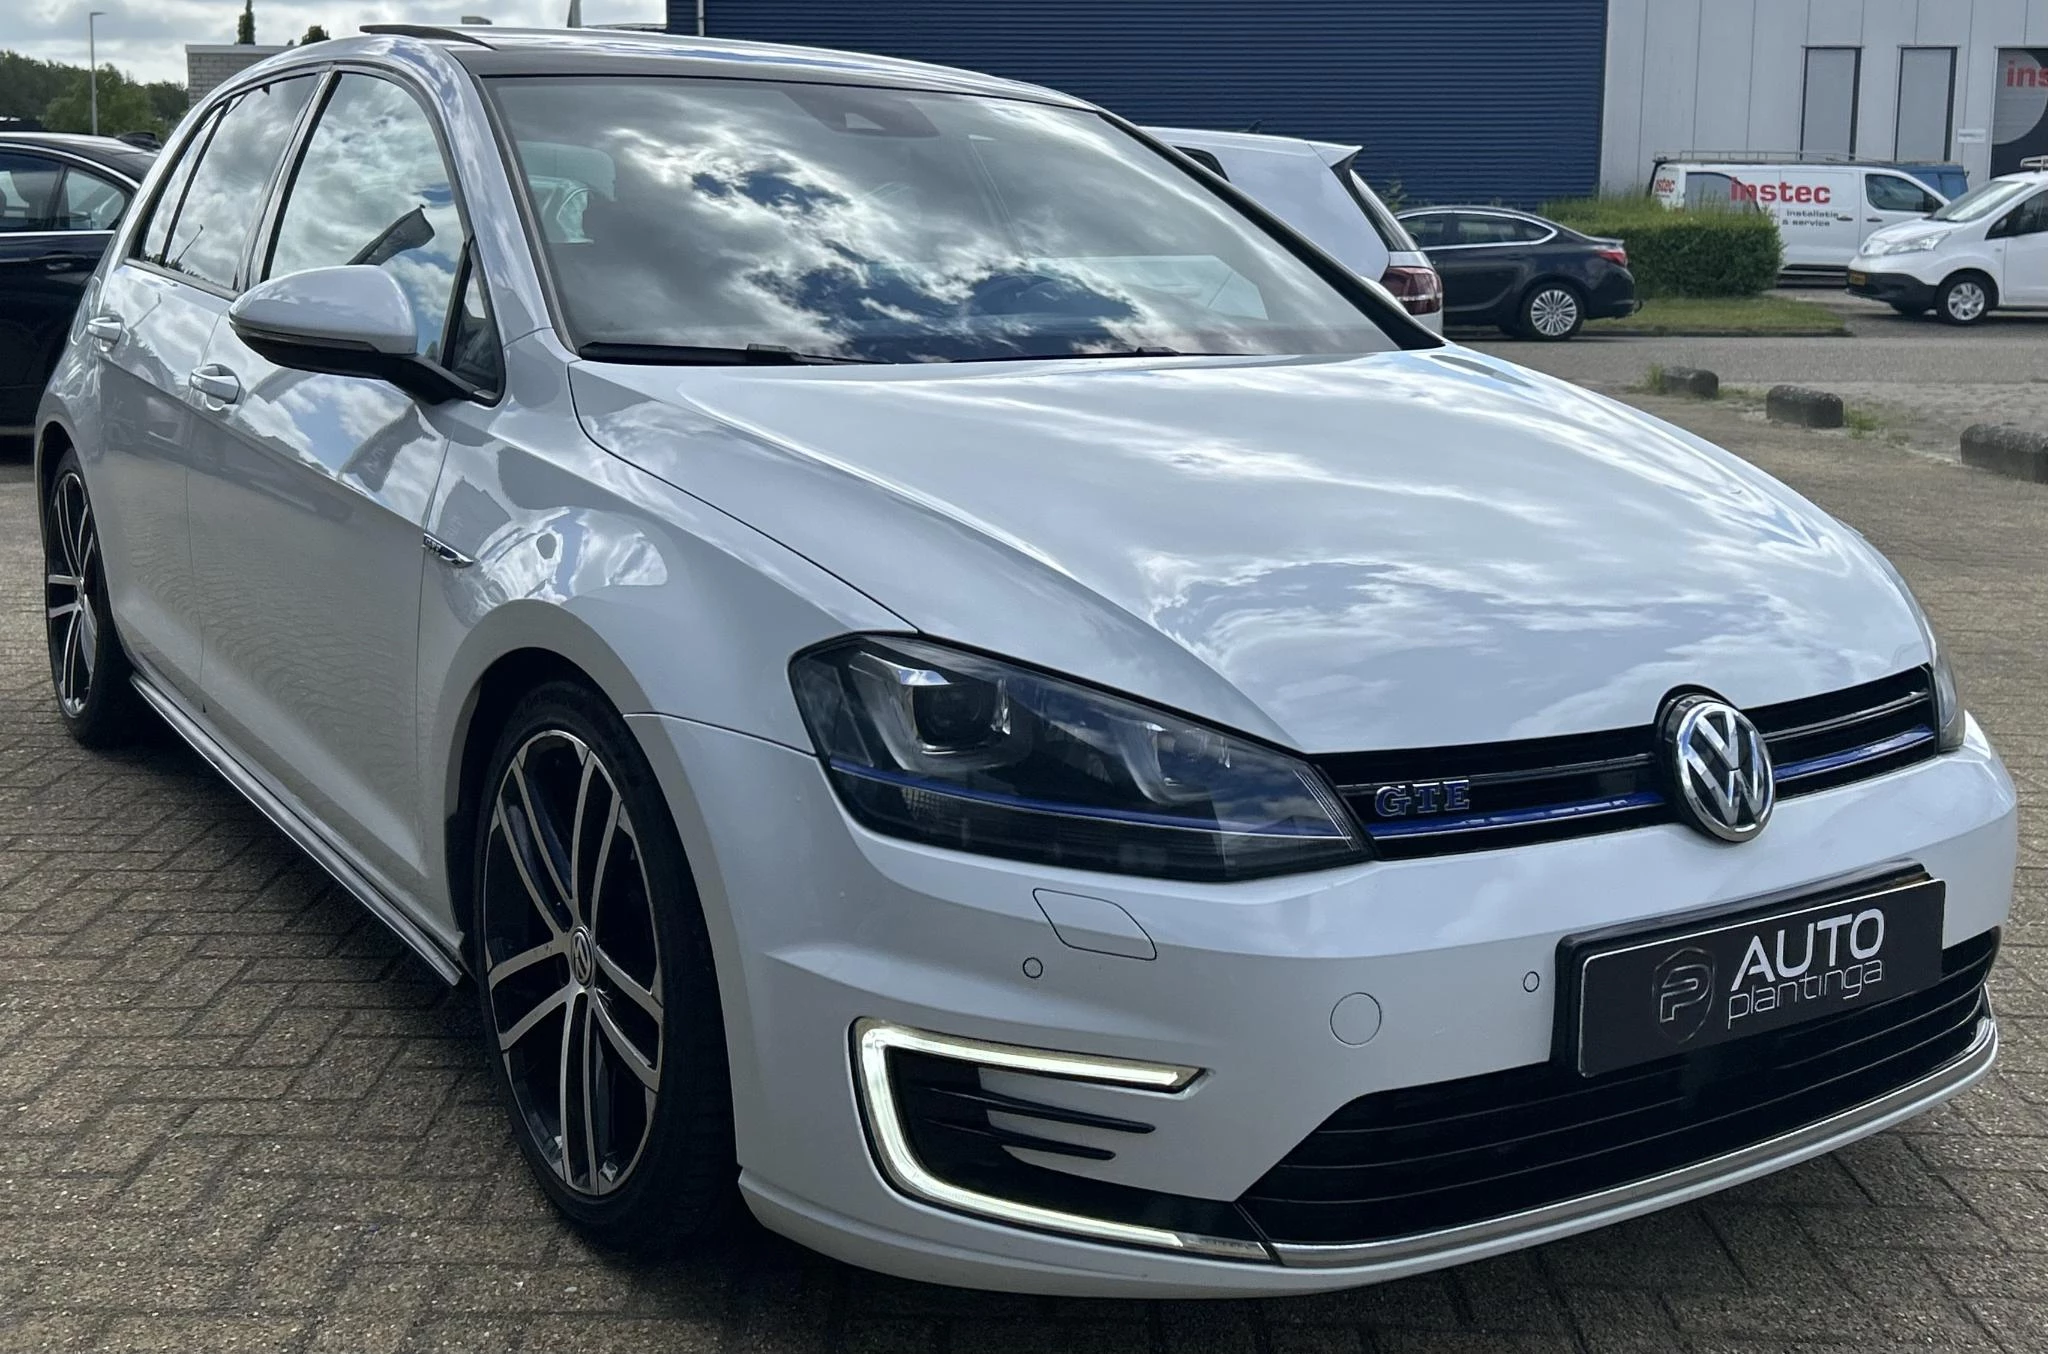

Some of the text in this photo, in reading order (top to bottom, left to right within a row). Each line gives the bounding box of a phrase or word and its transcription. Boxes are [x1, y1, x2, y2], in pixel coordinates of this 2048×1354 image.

[1731, 176, 1831, 204] instec
[1792, 219, 1831, 227] service
[1375, 778, 1471, 818] GTE
[1730, 907, 1886, 993] AUTO
[1727, 958, 1885, 1031] plantinga
